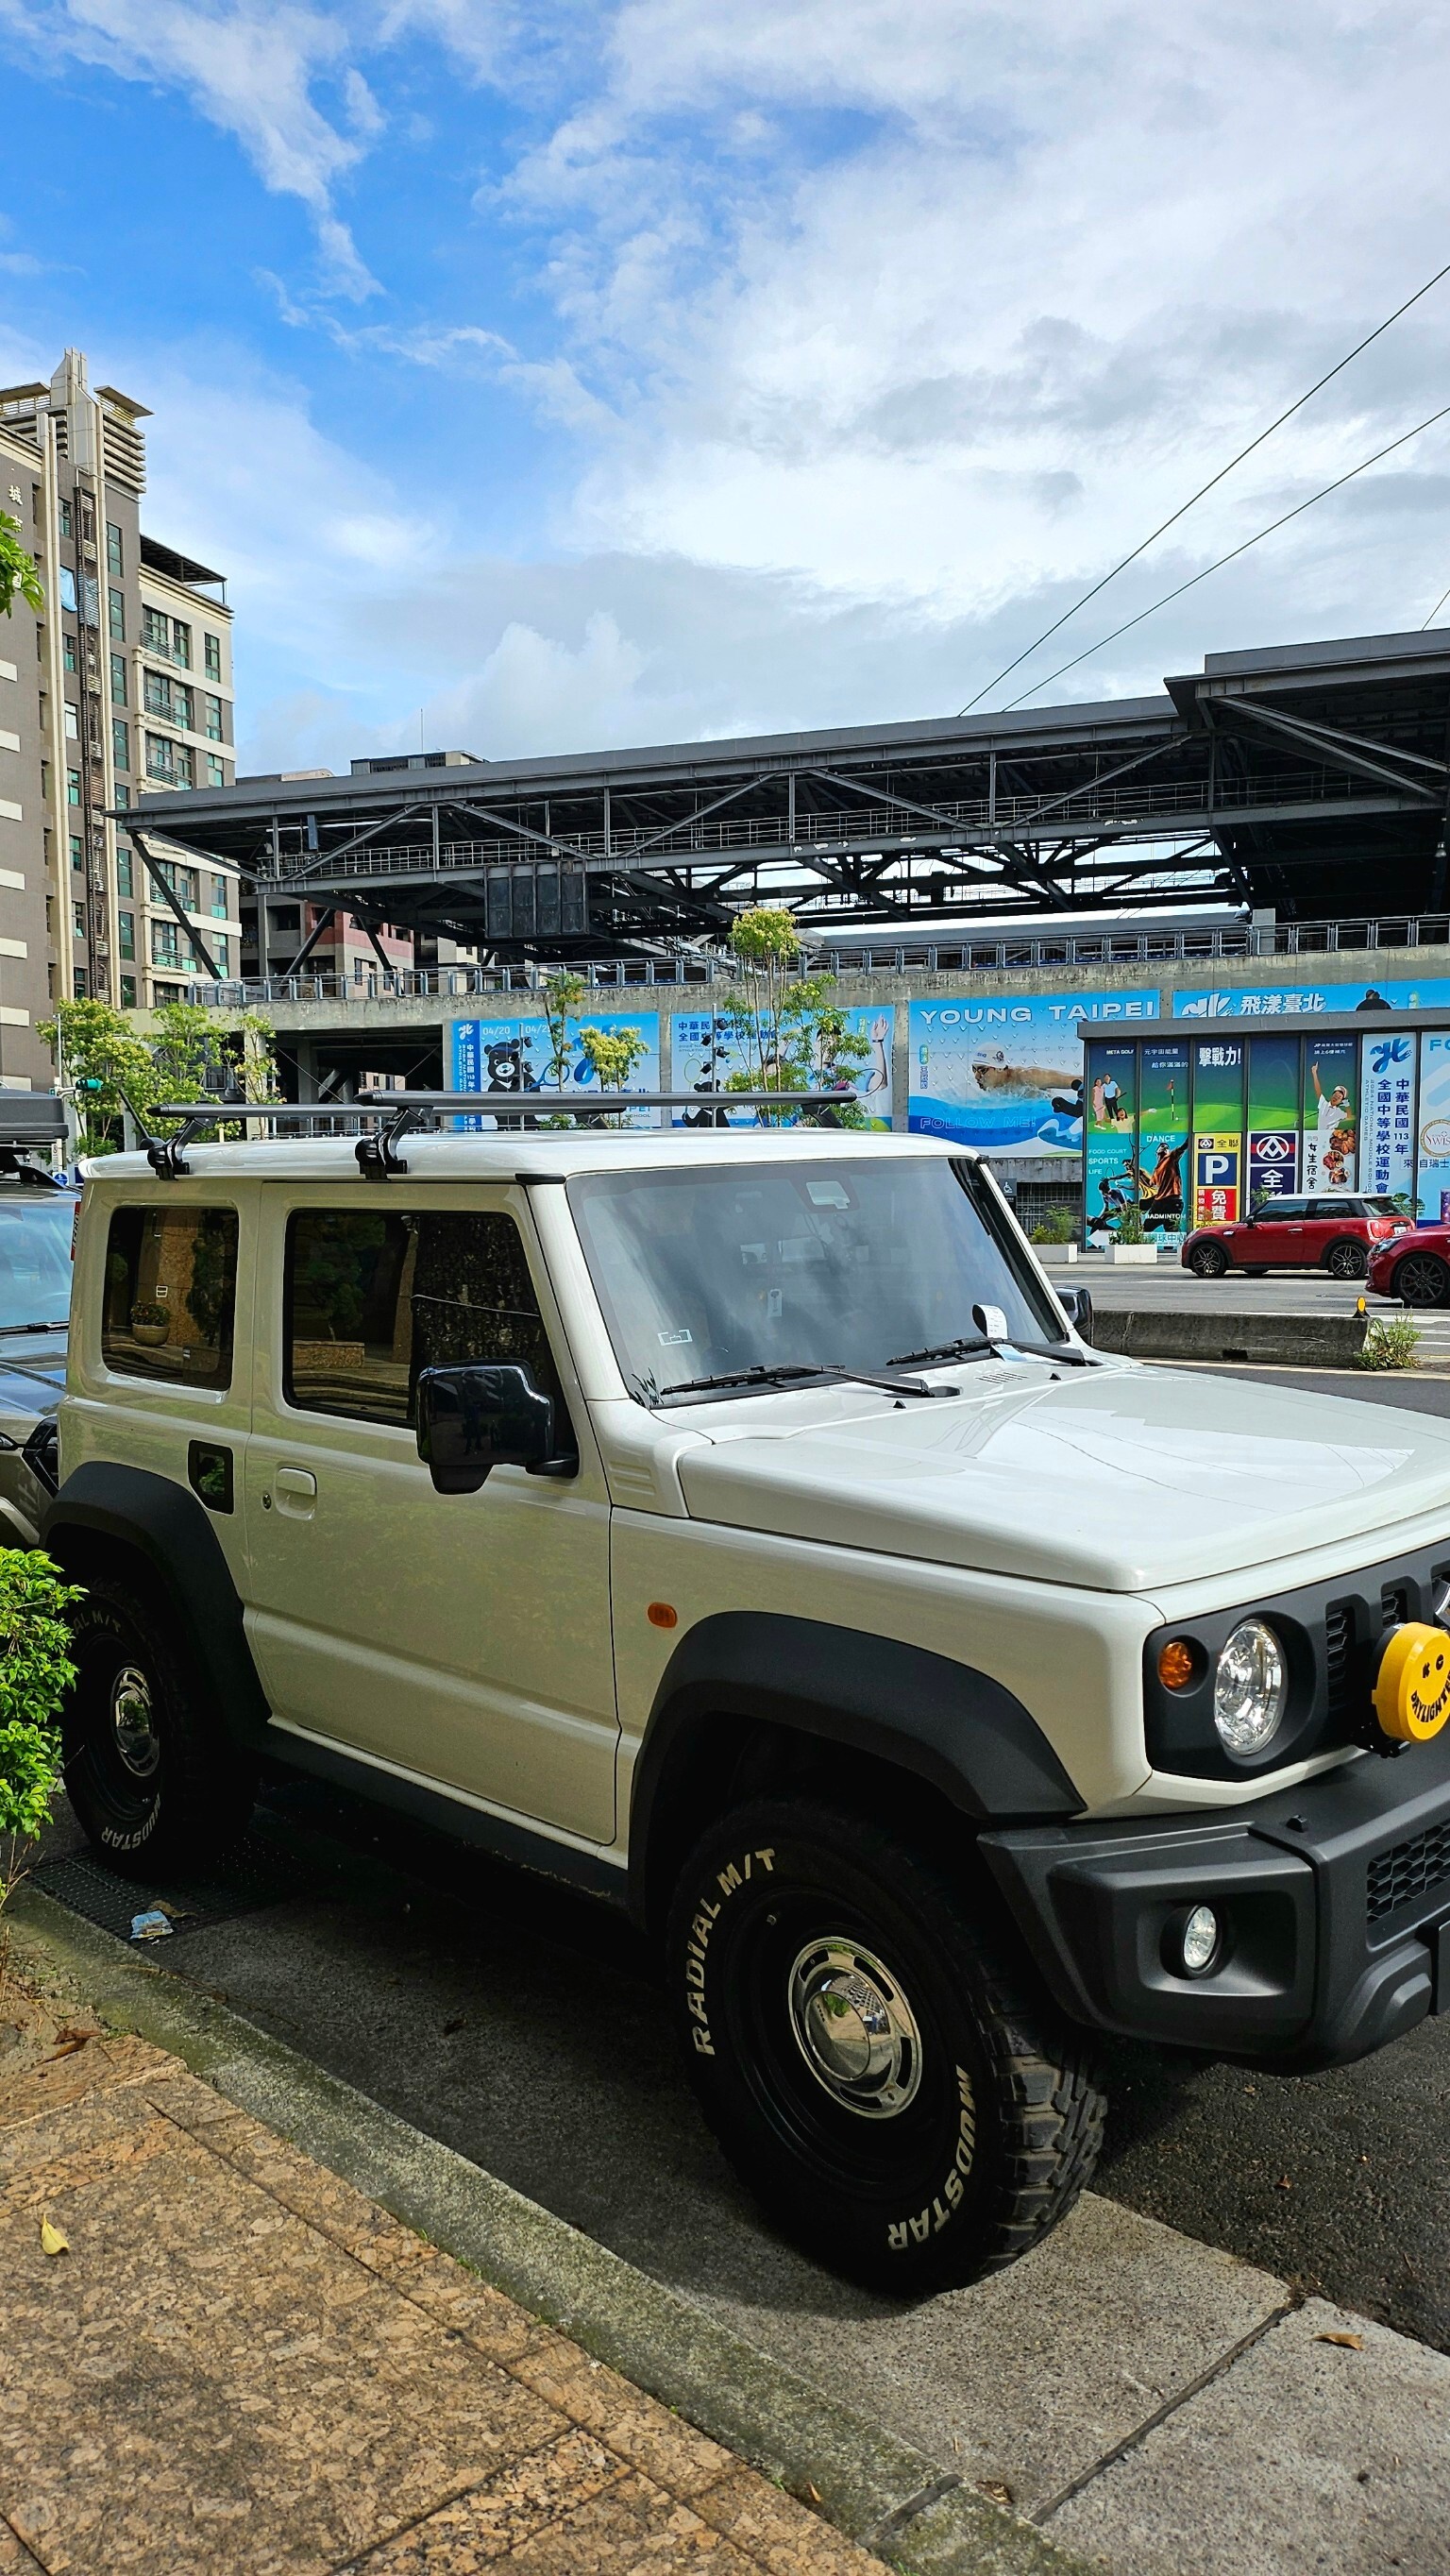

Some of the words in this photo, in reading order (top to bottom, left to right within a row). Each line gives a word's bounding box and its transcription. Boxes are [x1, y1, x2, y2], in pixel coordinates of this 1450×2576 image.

[919, 1007, 1032, 1025] YOUNG
[1048, 1001, 1154, 1021] TAIPEI
[1240, 993, 1326, 1014] 飛漾臺北
[482, 1026, 511, 1036] 04/20
[1199, 1046, 1241, 1067] 擊戰力!
[919, 1117, 996, 1129] FOLLOW
[1003, 1116, 1037, 1128] ME!
[1217, 1139, 1239, 1148] 全聯
[1374, 1079, 1392, 1194] 全國中等學校運動會
[1206, 1155, 1230, 1184] P
[1307, 1143, 1319, 1194] 女生宿舍
[1211, 1190, 1227, 1221] 免費
[685, 1897, 721, 2057] RADIAL
[717, 1848, 776, 1897] M/T
[886, 2064, 977, 2251] MUDSTAR
